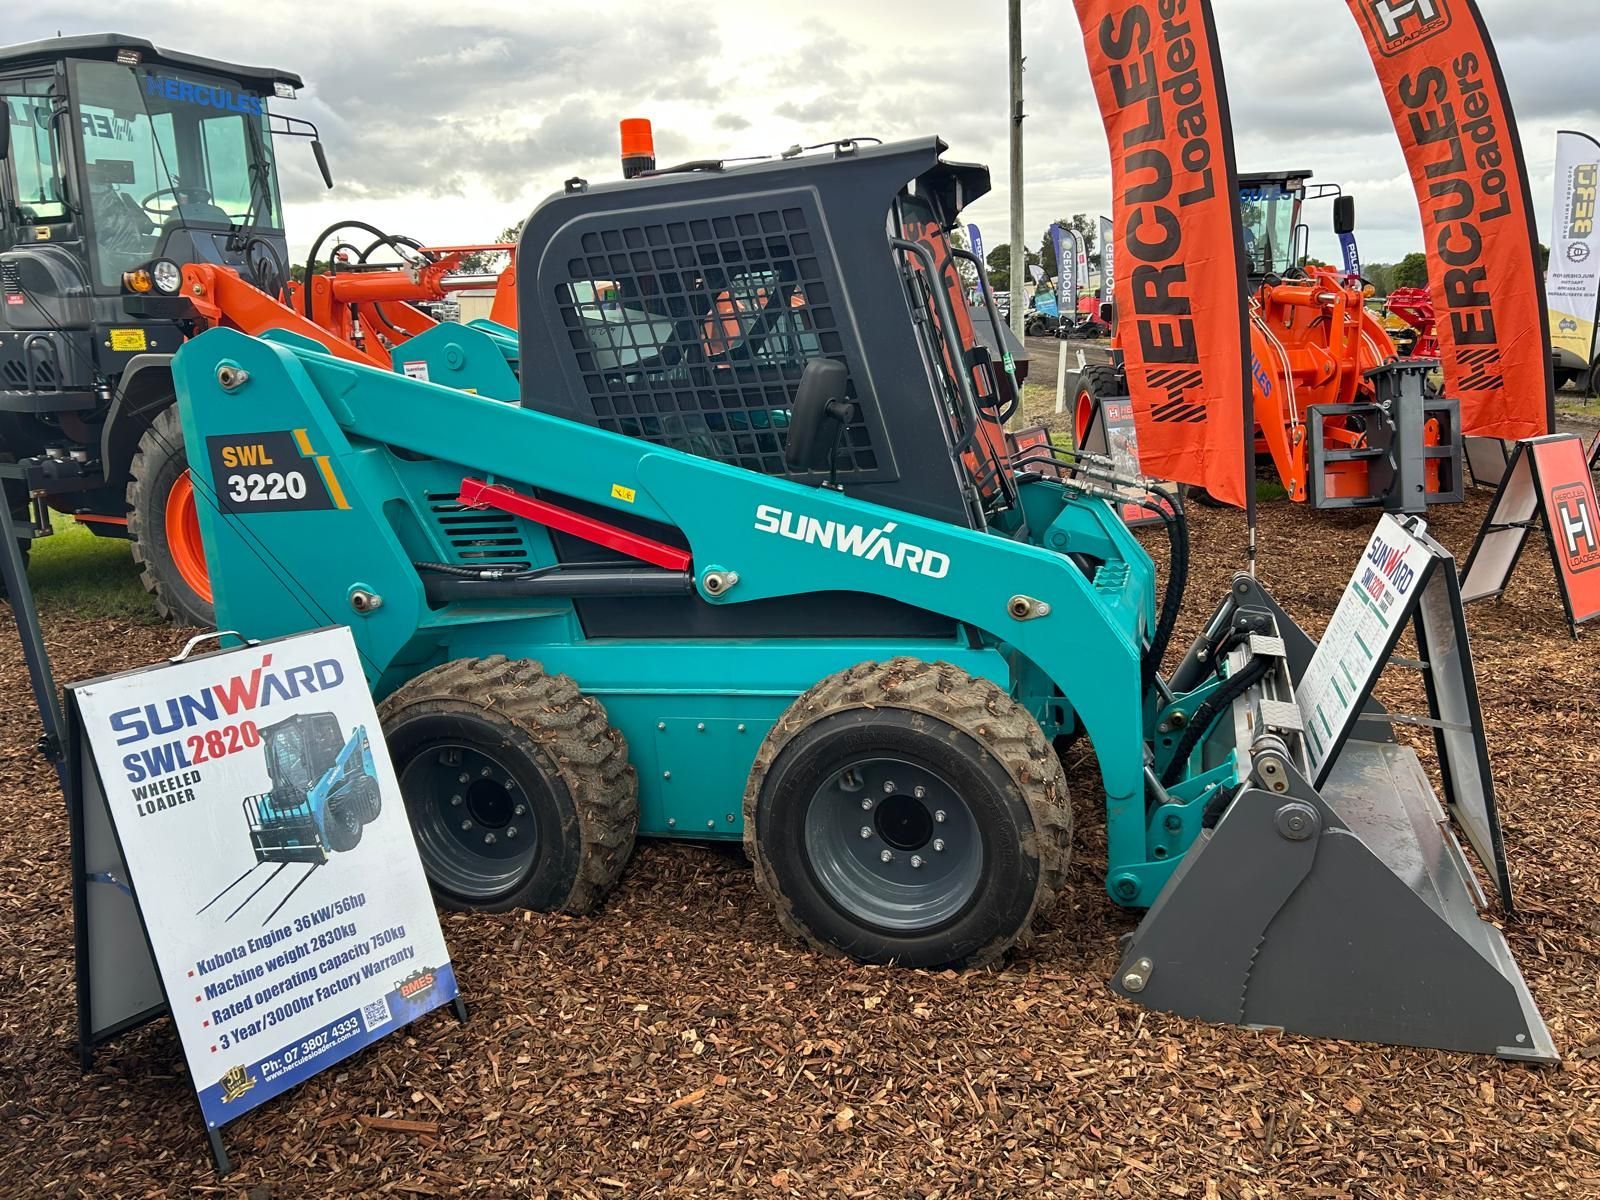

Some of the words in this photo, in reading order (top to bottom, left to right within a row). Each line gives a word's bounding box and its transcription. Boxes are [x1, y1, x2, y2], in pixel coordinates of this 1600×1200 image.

[1386, 19, 1446, 50] LOADERS
[146, 75, 263, 116] HERCULES
[1452, 51, 1512, 222] Loaders
[1099, 4, 1208, 423] HERCULES
[1398, 65, 1504, 391] HERCULES
[222, 444, 273, 468] SWL
[227, 471, 307, 503] 3220
[1555, 490, 1585, 500] HERCULES
[754, 504, 950, 579] SUNWARD
[1367, 536, 1414, 595] SUNWARD
[1570, 552, 1600, 567] LOADERS
[109, 654, 344, 746] SUNWARD
[123, 720, 260, 783] SWL2820
[131, 769, 202, 802] WHEELED
[137, 788, 196, 817] LOADER
[196, 945, 247, 976] Kubota
[247, 925, 293, 954] Engine
[204, 964, 264, 1001] Machine
[265, 941, 311, 972] weight
[310, 922, 357, 952] 2830kg
[212, 994, 254, 1026] Rated
[254, 966, 318, 1005] operating
[319, 941, 371, 974] capacity
[370, 925, 406, 950] 750kg
[219, 1034, 231, 1050] 3
[230, 993, 314, 1044] Year/3000hr
[315, 971, 361, 1003] Factory
[360, 945, 415, 979] Warranty
[401, 971, 434, 997] BMES
[261, 1058, 283, 1077] Ph:
[284, 1047, 299, 1064] 07
[301, 1031, 329, 1055] 3807
[331, 1016, 359, 1038] 4333
[264, 1027, 361, 1082] www.herculesloaders.com.au
